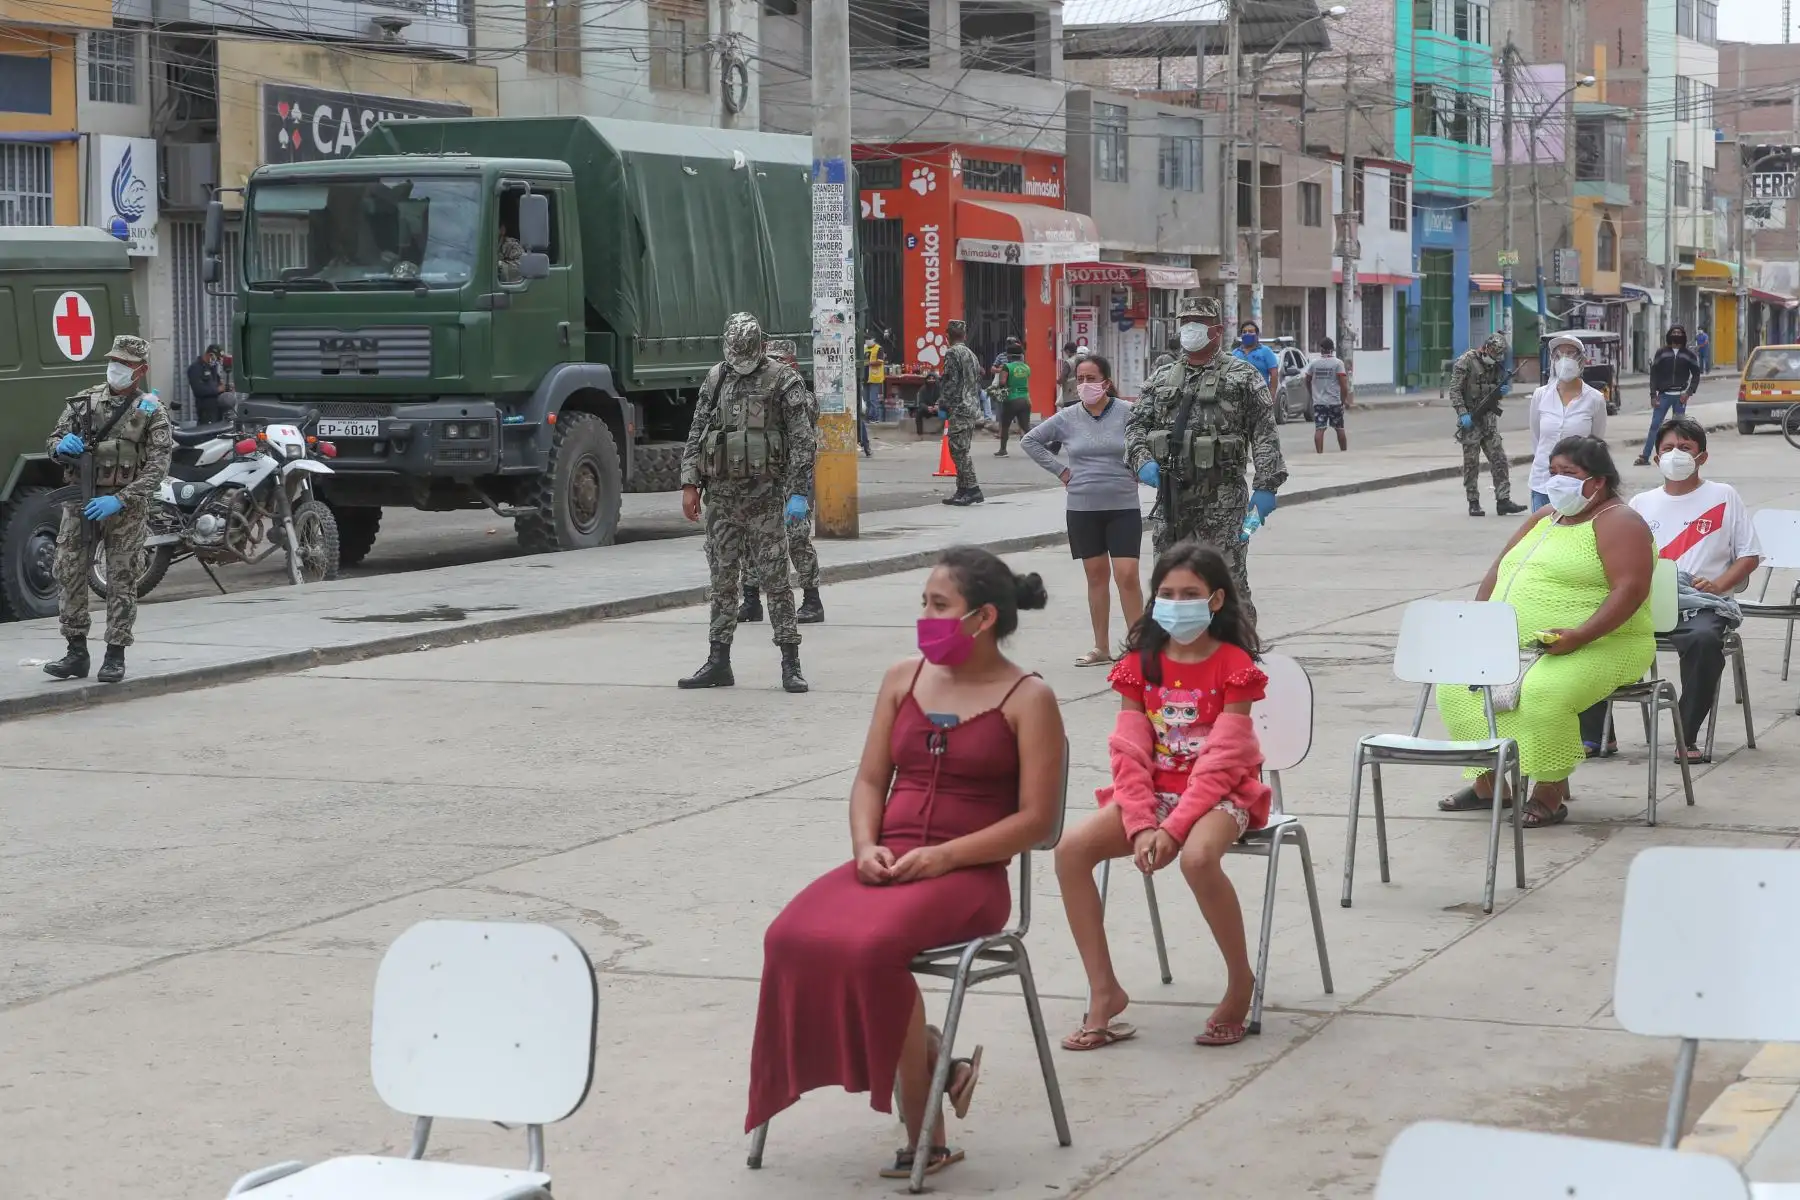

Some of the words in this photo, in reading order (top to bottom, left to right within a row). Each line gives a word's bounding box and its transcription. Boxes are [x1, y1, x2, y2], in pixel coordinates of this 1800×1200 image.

[1025, 176, 1061, 198] mimaskot
[960, 248, 1001, 259] mimaskot
[920, 224, 940, 328] mimaskot
[1068, 268, 1130, 282] BOTICA
[319, 338, 378, 351] MAN
[318, 424, 377, 436] EP-60147
